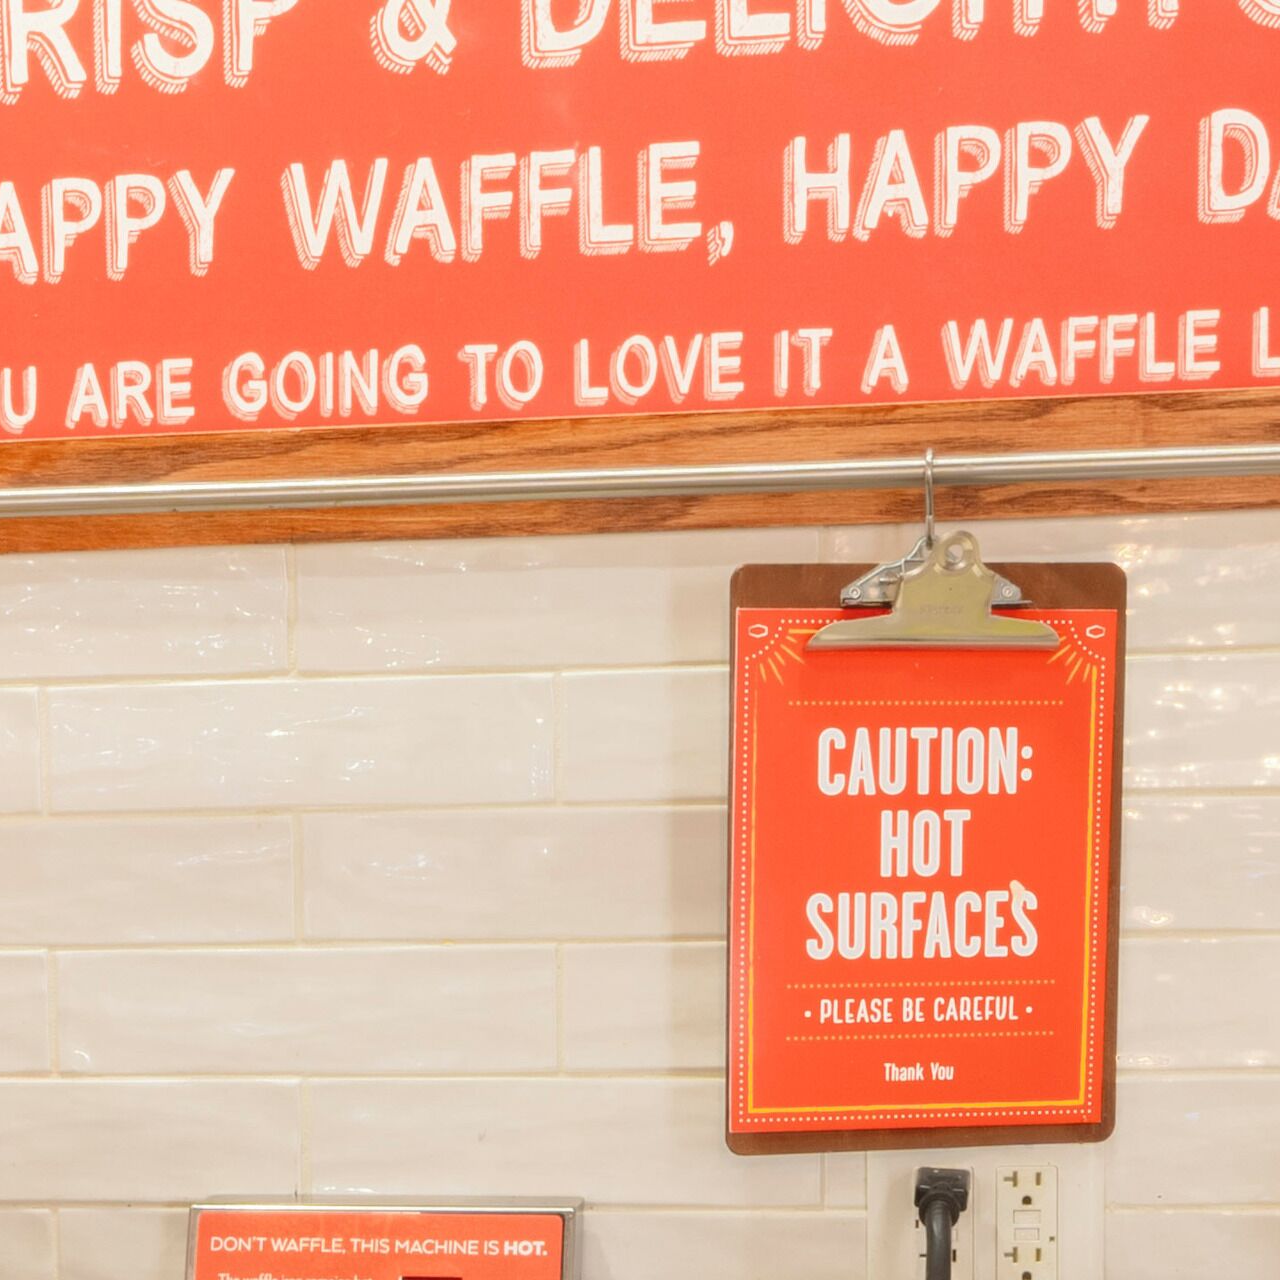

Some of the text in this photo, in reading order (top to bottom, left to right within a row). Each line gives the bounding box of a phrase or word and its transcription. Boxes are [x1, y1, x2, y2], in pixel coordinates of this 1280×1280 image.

[281, 141, 734, 268] WAFFLE,
[783, 114, 1149, 245] HAPPY
[66, 357, 195, 428] ARE
[223, 343, 429, 420] GOING
[458, 340, 543, 410] TO
[574, 331, 744, 407] LOVE
[774, 328, 832, 395] IT
[861, 324, 909, 393] A
[941, 309, 1220, 390] WAFFLE
[817, 727, 1033, 796] CAUTION:
[880, 809, 971, 877] HOT
[806, 888, 1038, 960] SURFACES
[820, 996, 1019, 1024] PLEASE BE CAREFUL
[884, 1063, 954, 1081] Thank You
[210, 1236, 548, 1256] DON'T WAFFLE, THIS MACHINE IS HOT.
